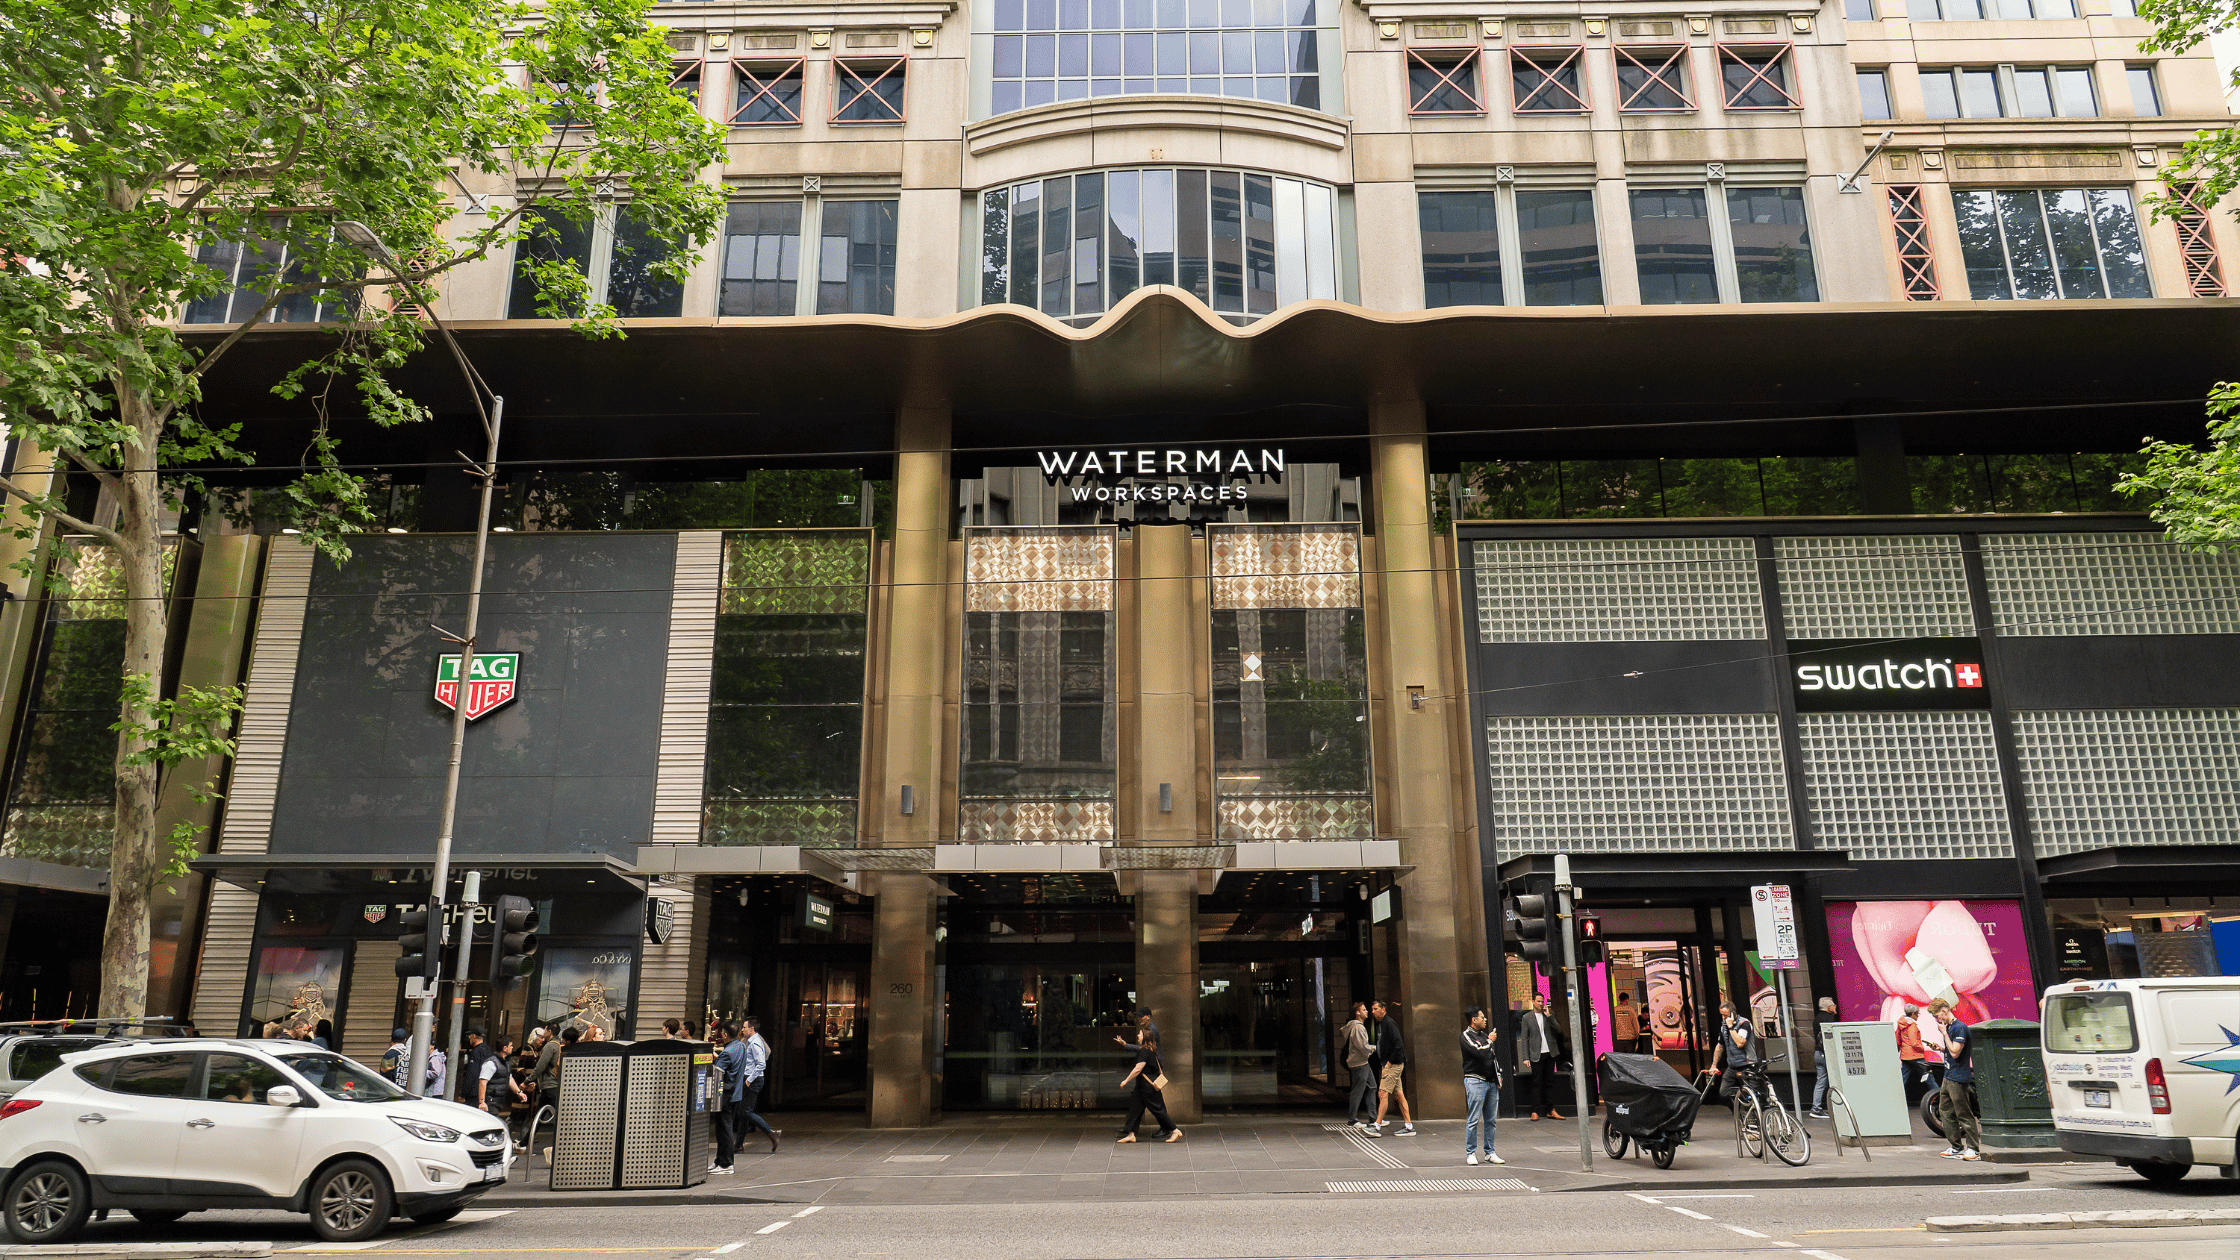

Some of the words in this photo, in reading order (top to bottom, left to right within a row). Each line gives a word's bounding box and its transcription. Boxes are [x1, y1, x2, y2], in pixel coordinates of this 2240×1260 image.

[1037, 448, 1284, 475] WATERMAN
[1071, 485, 1248, 501] WORKSPACES
[446, 657, 510, 678] TAG
[1797, 658, 1954, 690] swatch
[440, 683, 511, 714] HUER
[658, 902, 672, 917] TAG
[1777, 924, 1793, 934] 2P
[890, 983, 913, 994] 260
[1848, 1067, 1865, 1075] 4579
